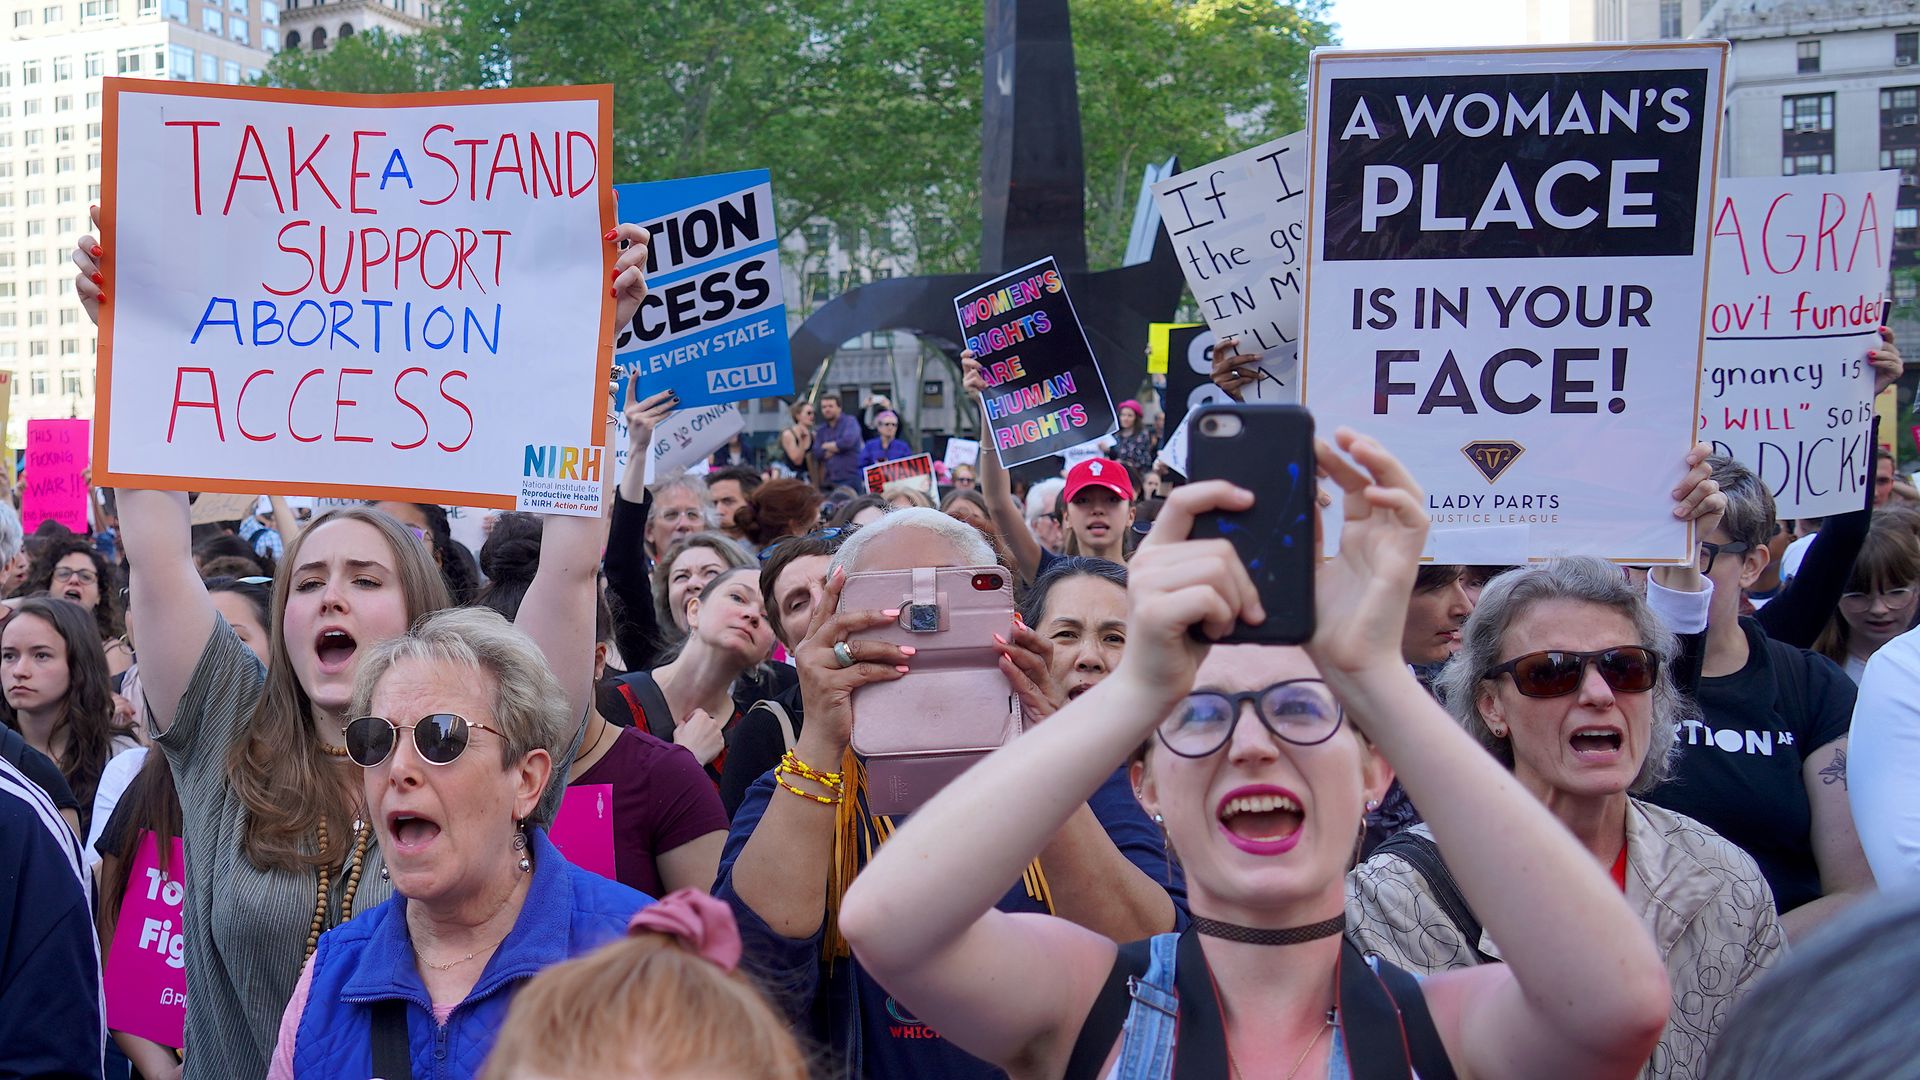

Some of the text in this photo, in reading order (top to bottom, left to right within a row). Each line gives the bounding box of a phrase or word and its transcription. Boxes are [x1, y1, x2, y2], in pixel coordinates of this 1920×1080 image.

[1340, 87, 1692, 141] A WOMAN'S
[165, 121, 597, 216] TAKE A STAND
[1163, 147, 1304, 236] If I
[1361, 158, 1661, 233] PLACE
[262, 220, 512, 296] SUPPORT
[643, 192, 760, 274] TION
[1186, 220, 1303, 280] the go
[1714, 192, 1882, 276] AGRA
[960, 270, 1063, 328] WOMEN'S
[1205, 267, 1301, 321] IN M
[1352, 284, 1654, 330] IS IN YOUR
[1789, 290, 1883, 331] funded
[190, 297, 501, 354] ABORTION
[650, 340, 711, 374] EVERY
[713, 319, 775, 353] STATE.
[967, 310, 1052, 360] RIGHTS
[712, 365, 773, 391] ACLU
[980, 355, 1027, 388] ARE
[986, 371, 1078, 421] HUMAN
[1373, 347, 1629, 415] FACE!
[1704, 359, 1861, 398] gnancy is
[167, 367, 474, 452] ACCESS
[996, 403, 1089, 450] RIGHTS
[30, 430, 52, 444] THIS
[522, 480, 599, 493] National Institute for
[523, 444, 602, 482] NIRH
[1758, 430, 1870, 506] DICK!
[522, 489, 599, 502] Reproductive Health
[531, 499, 552, 508] NIRH
[554, 501, 578, 510] Action
[579, 503, 598, 512] Fund
[1429, 494, 1560, 509] LADY PARTS
[1429, 513, 1559, 524] JUSTICE LEAGUE
[1777, 731, 1795, 745] AF
[146, 867, 184, 907] To
[889, 1025, 941, 1039] WHIC
